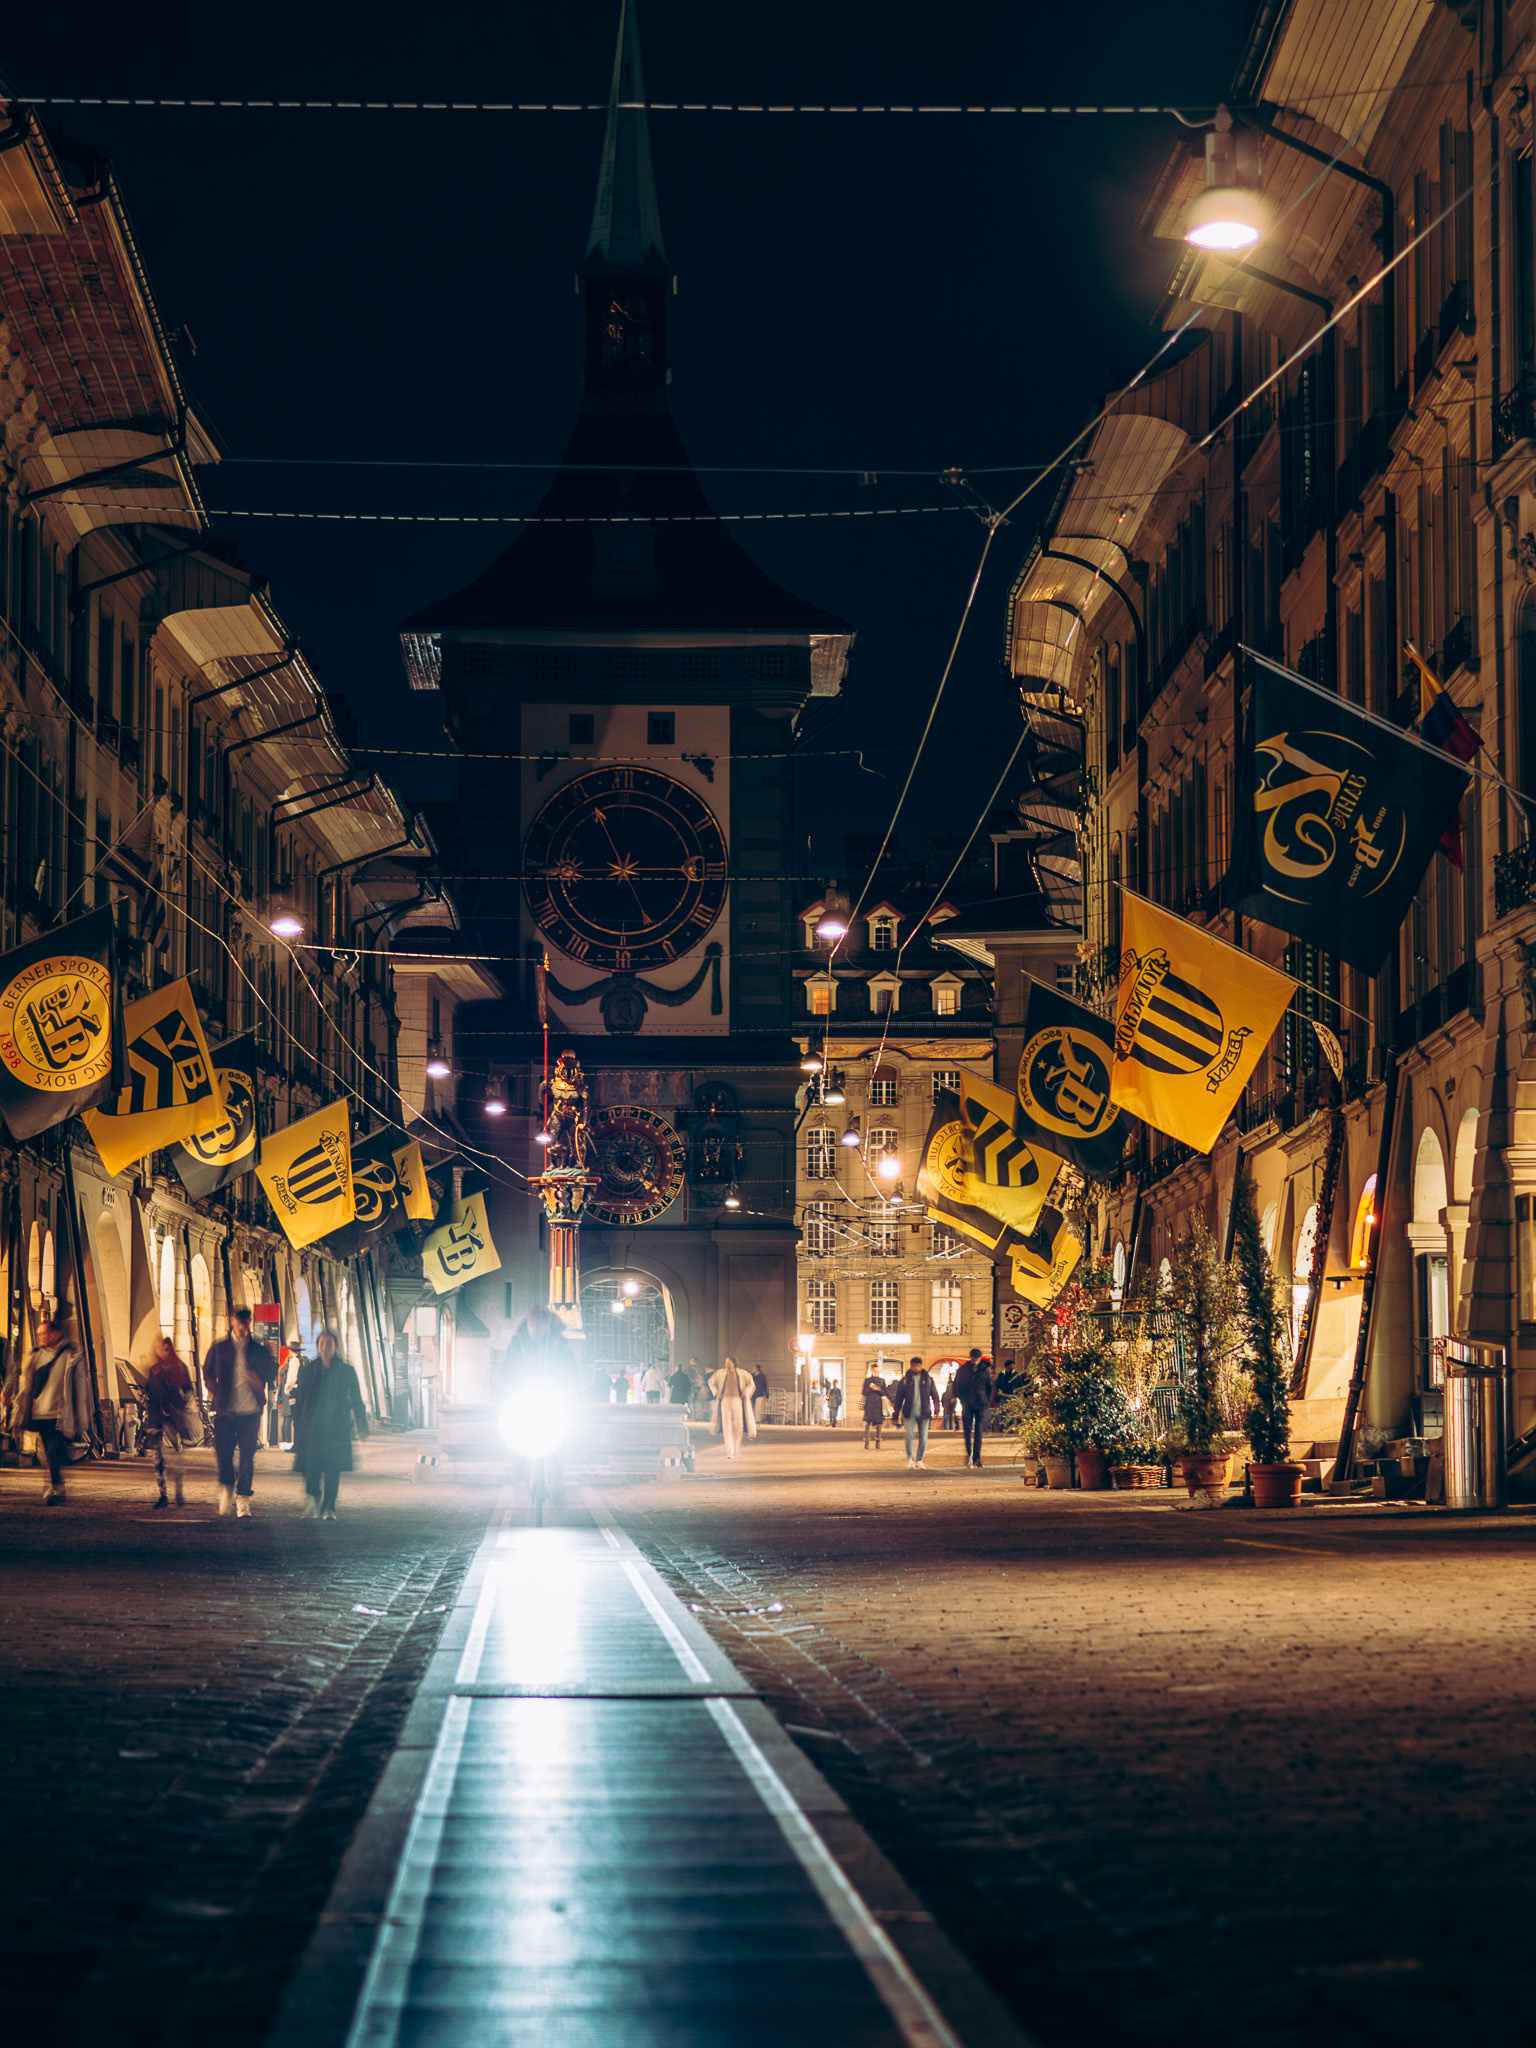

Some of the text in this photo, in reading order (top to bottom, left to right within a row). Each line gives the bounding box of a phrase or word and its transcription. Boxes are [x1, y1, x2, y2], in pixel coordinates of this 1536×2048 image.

[3, 960, 112, 1010] BERNER SPORTC
[0, 1032, 21, 1068] 1898
[18, 1014, 44, 1064] YB FOR EVER
[166, 1019, 207, 1090] YB
[34, 1072, 76, 1087] BOYS
[228, 1071, 246, 1082] BSC
[277, 1182, 293, 1206] BERN
[437, 1204, 484, 1276] YB
